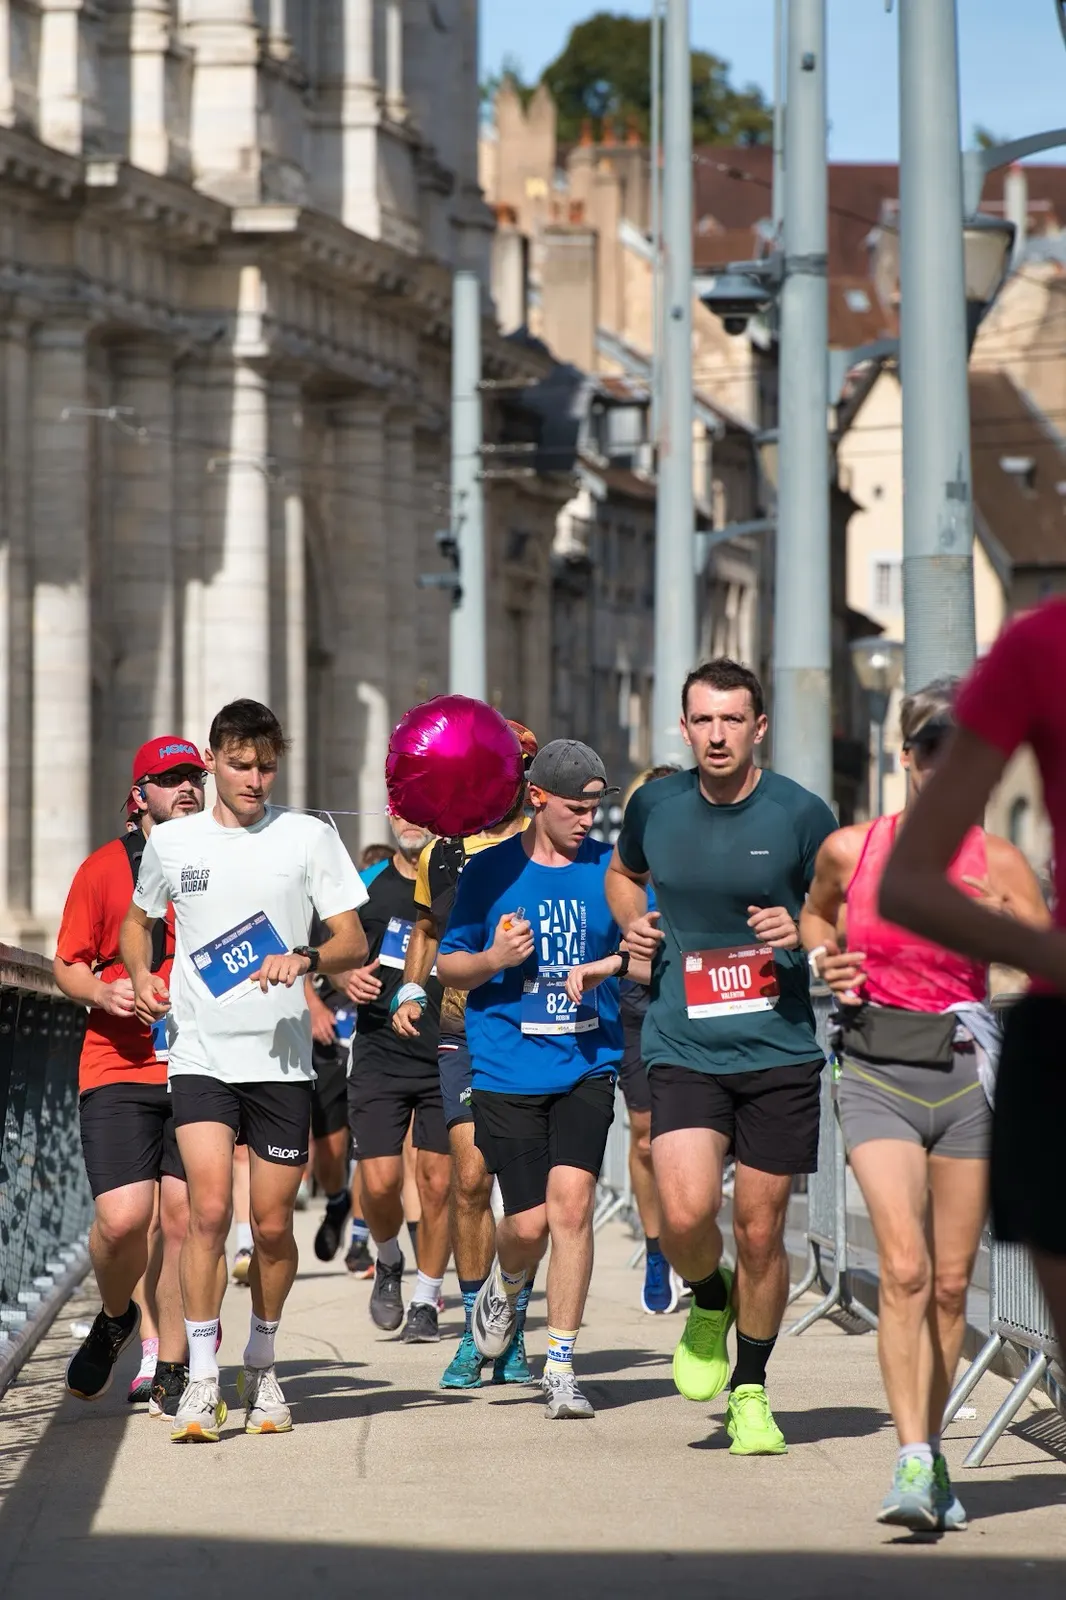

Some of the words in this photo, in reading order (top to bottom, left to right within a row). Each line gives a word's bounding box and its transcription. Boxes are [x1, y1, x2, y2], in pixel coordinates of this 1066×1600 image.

[159, 744, 197, 759] HOKA
[180, 869, 211, 882] BOUCLES
[180, 879, 209, 894] VAUBAN
[222, 940, 259, 974] 832
[708, 964, 752, 992] 1010
[267, 1144, 300, 1160] VELCAP
